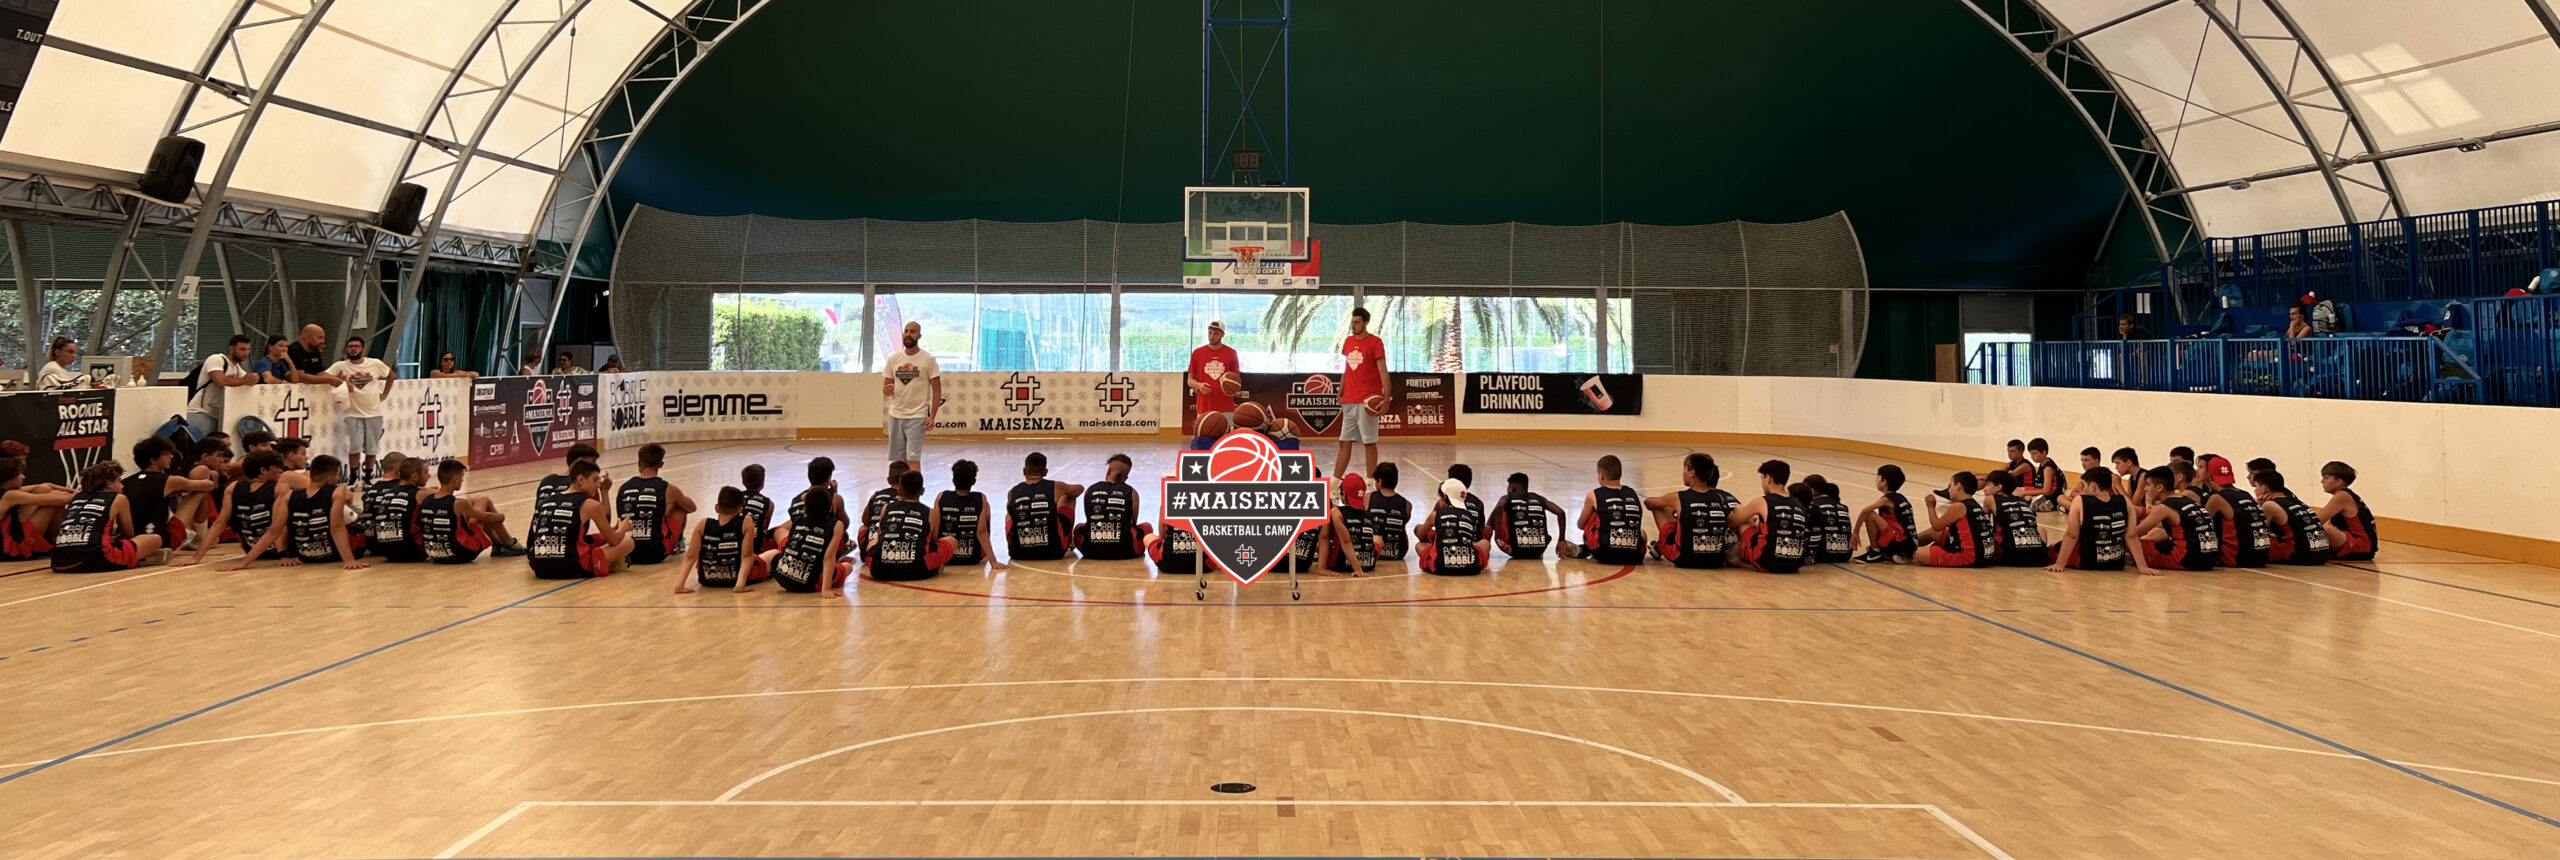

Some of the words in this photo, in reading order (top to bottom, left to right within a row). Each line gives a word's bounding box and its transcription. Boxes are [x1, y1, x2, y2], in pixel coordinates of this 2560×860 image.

[16, 29, 43, 42] T.OUT
[1406, 378, 1442, 388] FONTEVIVA
[1480, 375, 1544, 390] PLAYFOOL
[610, 378, 646, 408] BOBBLE
[1290, 397, 1342, 406] #MAISENZ
[1480, 394, 1544, 410] DRINKING
[58, 402, 103, 420] ROOKIE
[1407, 404, 1444, 416] BOBBLE
[611, 405, 646, 431] BOBBLE
[1079, 418, 1157, 428] mai-senza.com
[1408, 416, 1444, 425] BOBBLE
[56, 421, 76, 436] ALL
[78, 418, 108, 434] STAR
[979, 418, 1065, 430] MAISENZA
[1090, 522, 1122, 530] BOBBLE
[1019, 534, 1048, 545] BOBBLE
[1090, 530, 1120, 540] BOBBLE
[1517, 536, 1546, 544] BOBBLE
[882, 540, 917, 551] BOBBLE
[1173, 542, 1198, 550] BOBB
[1610, 536, 1638, 546] BOBBLE
[882, 550, 916, 560] BOBBLE
[1444, 546, 1475, 556] BOBBLE
[1444, 554, 1475, 564] BOBBLE
